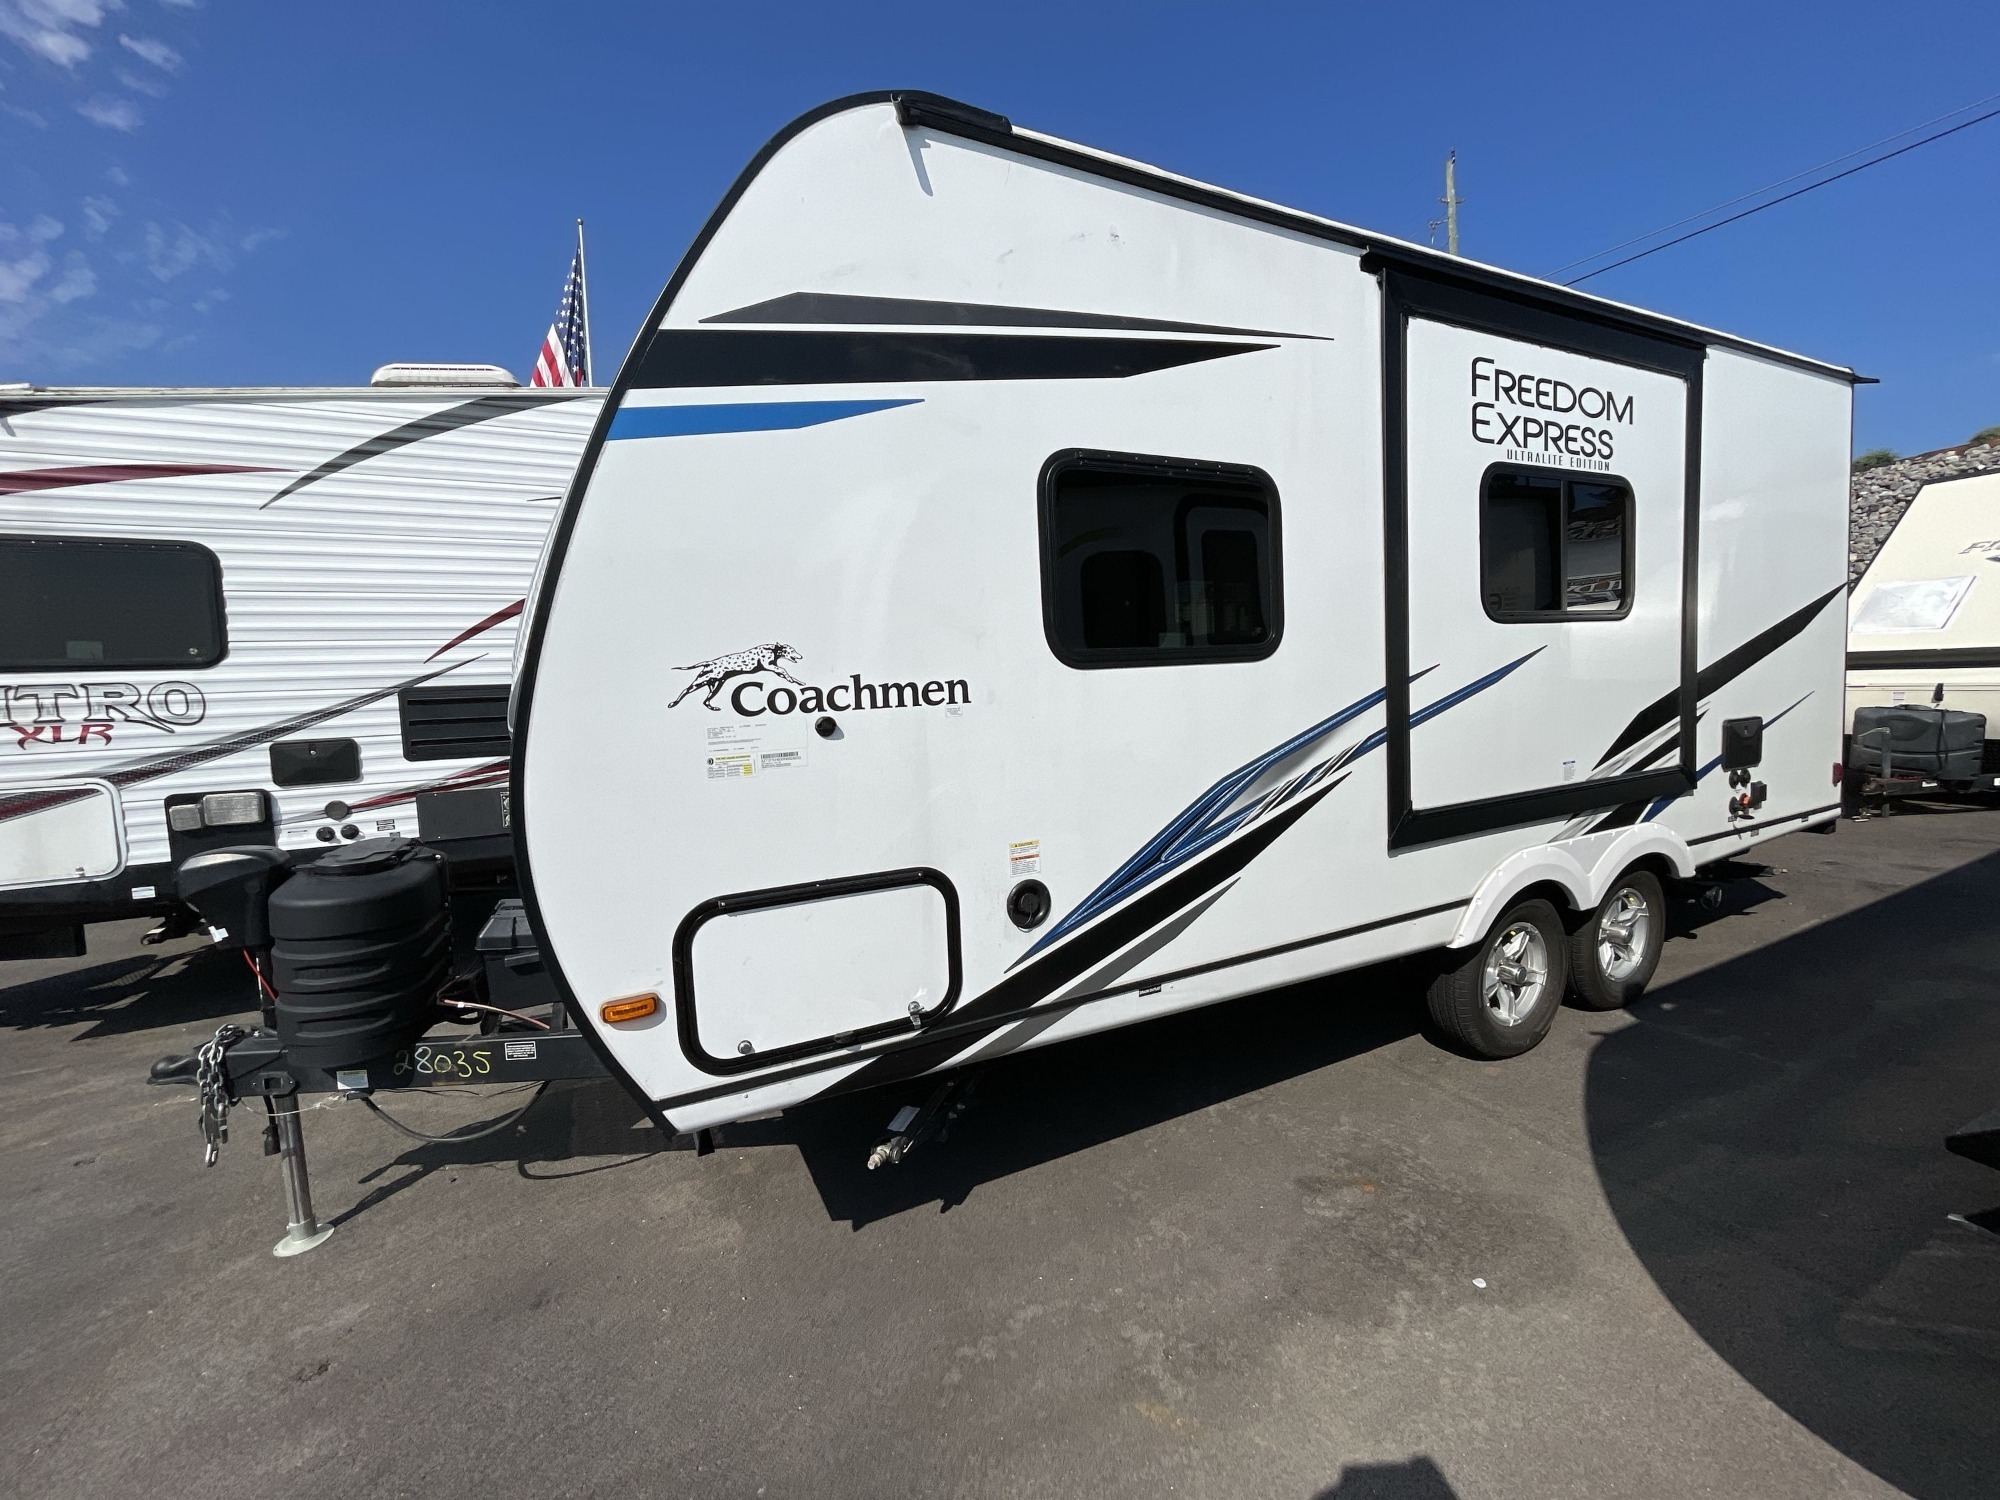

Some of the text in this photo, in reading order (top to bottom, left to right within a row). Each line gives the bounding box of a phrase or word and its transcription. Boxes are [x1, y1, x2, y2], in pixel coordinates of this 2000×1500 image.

[1471, 356, 1634, 425] FREEDOM
[1471, 401, 1614, 460] EXPRESS
[1507, 449, 1610, 471] ULTRALITE EDITION
[731, 673, 972, 717] Coachmen
[10, 723, 115, 750] XLR
[393, 1046, 492, 1078] 28035
